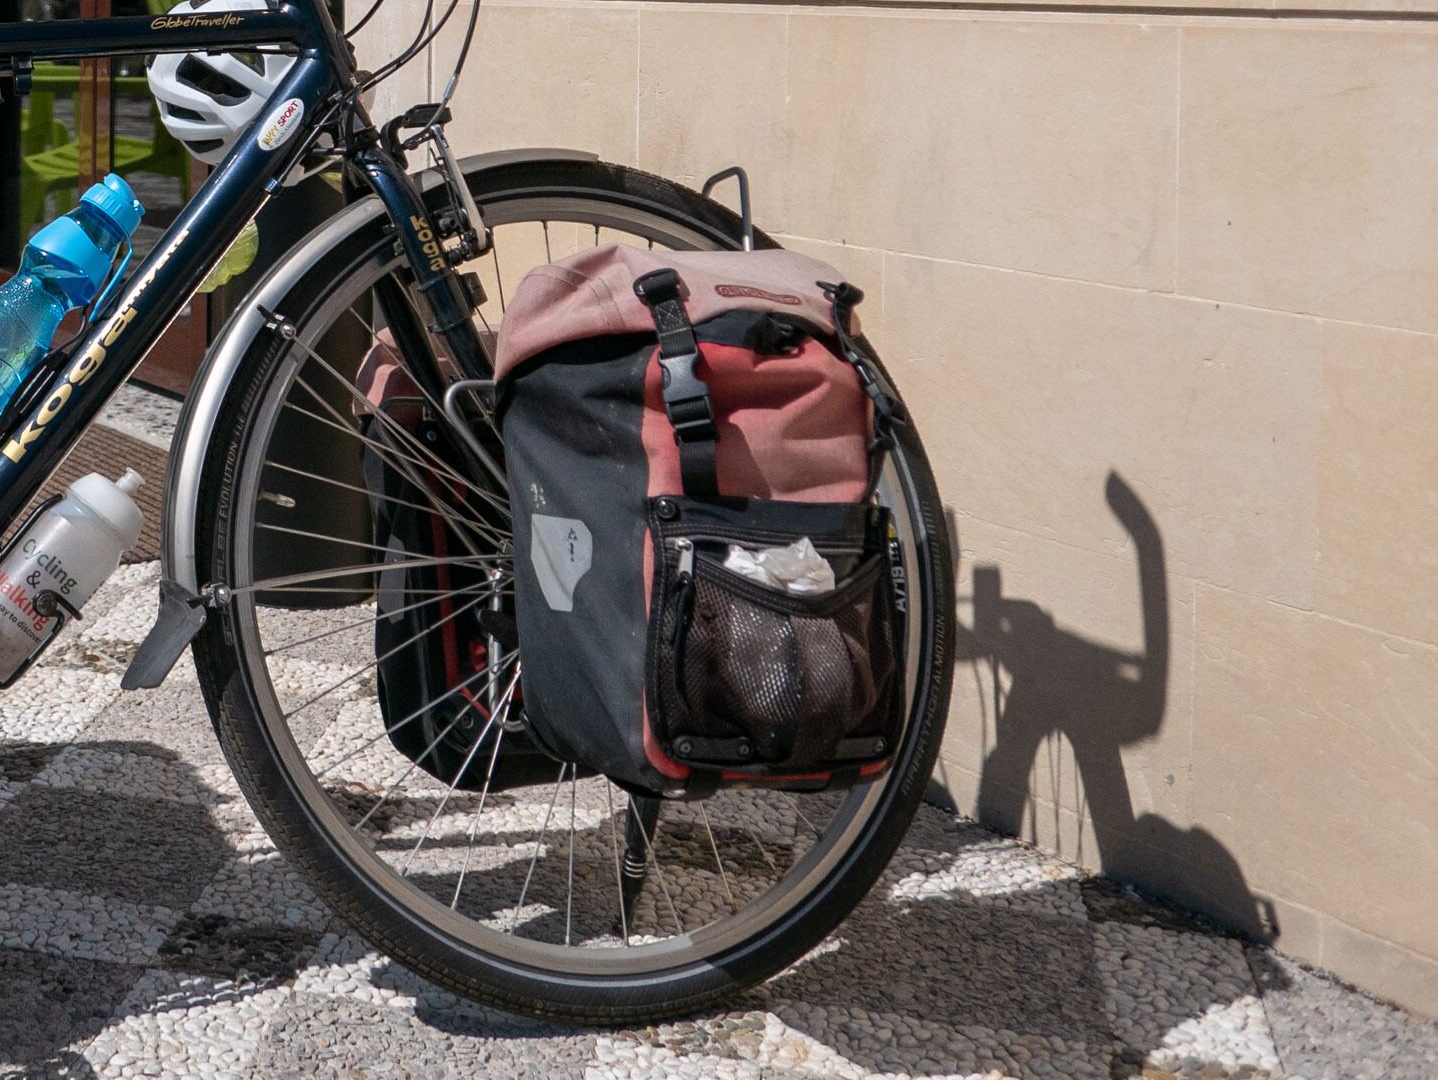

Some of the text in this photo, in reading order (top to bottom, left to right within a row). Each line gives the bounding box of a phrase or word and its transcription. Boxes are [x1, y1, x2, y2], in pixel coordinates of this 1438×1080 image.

[277, 100, 299, 127] SPORT
[22, 538, 78, 596] Cycling
[26, 569, 42, 590] &
[9, 612, 18, 623] to
